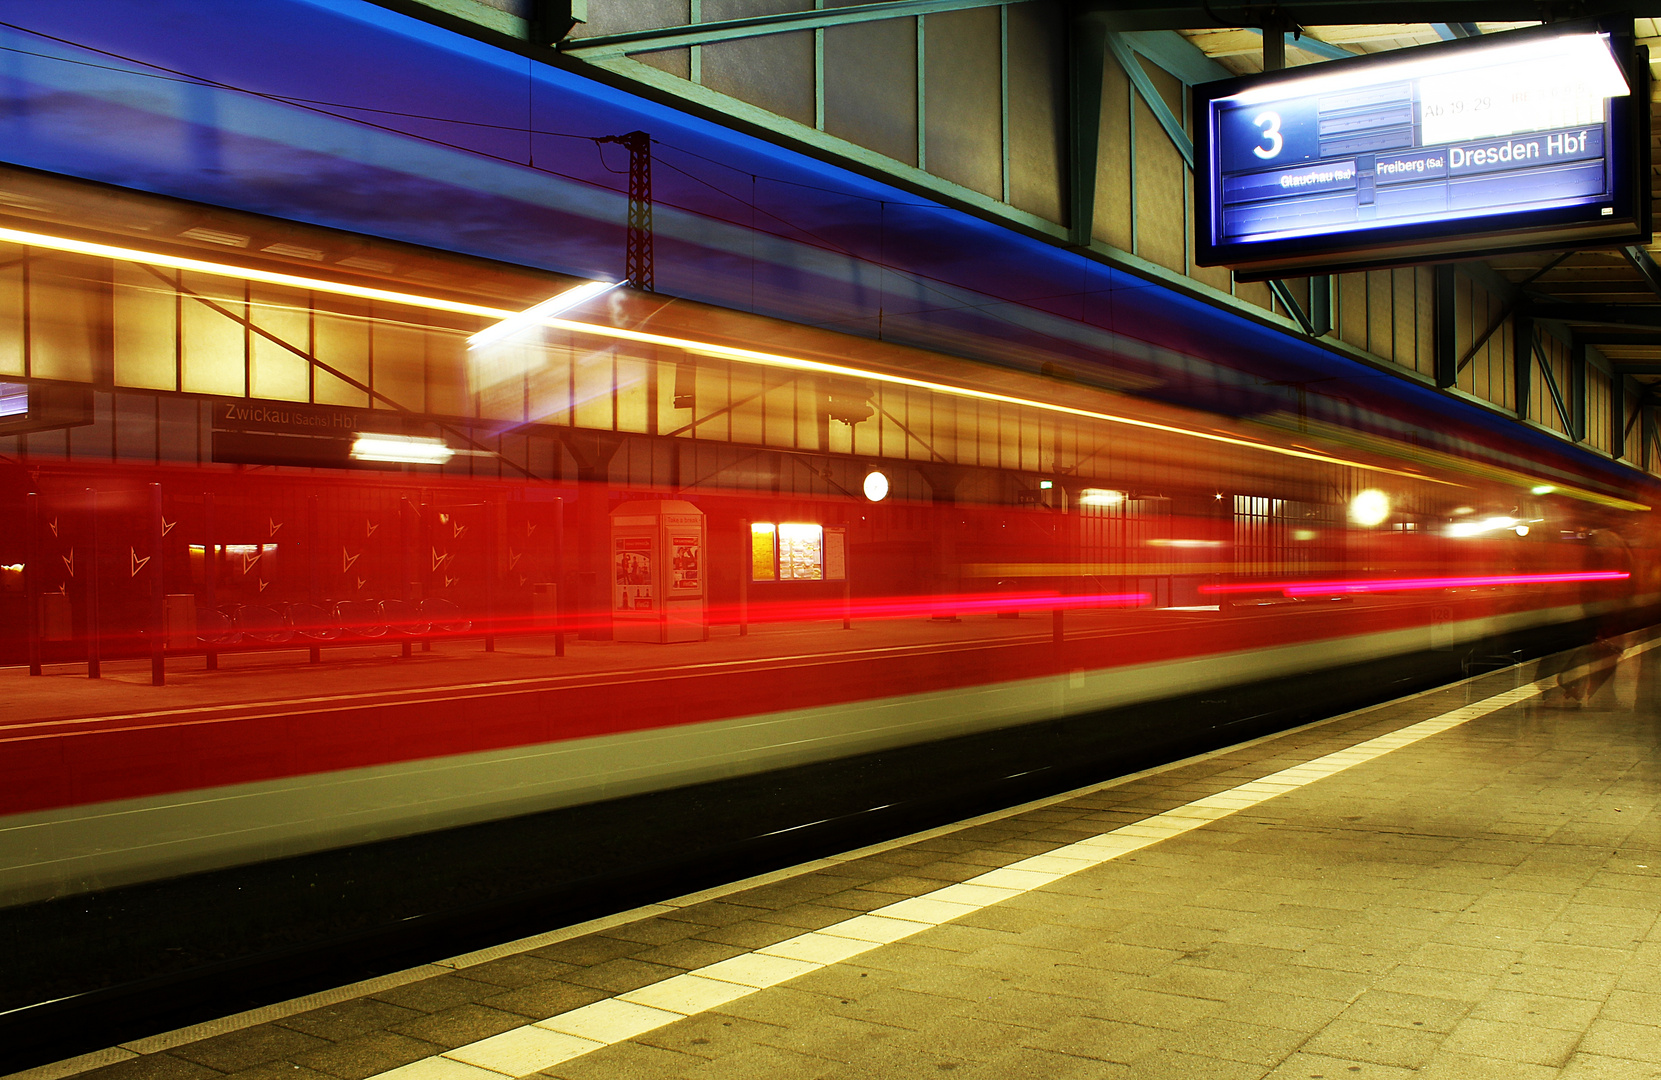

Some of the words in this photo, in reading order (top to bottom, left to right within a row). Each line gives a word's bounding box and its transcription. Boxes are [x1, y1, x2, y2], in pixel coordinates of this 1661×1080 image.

[1425, 104, 1444, 118] Ab
[1252, 111, 1284, 160] 3
[1280, 170, 1334, 188] Glauchau
[1377, 159, 1424, 175] Freiberg
[1426, 156, 1444, 169] (Sa)
[1450, 141, 1539, 168] Dresden
[1547, 131, 1587, 156] Hbf
[225, 403, 289, 423] Zwickau
[291, 414, 331, 428] (Sachs)
[333, 415, 358, 429] Hbf
